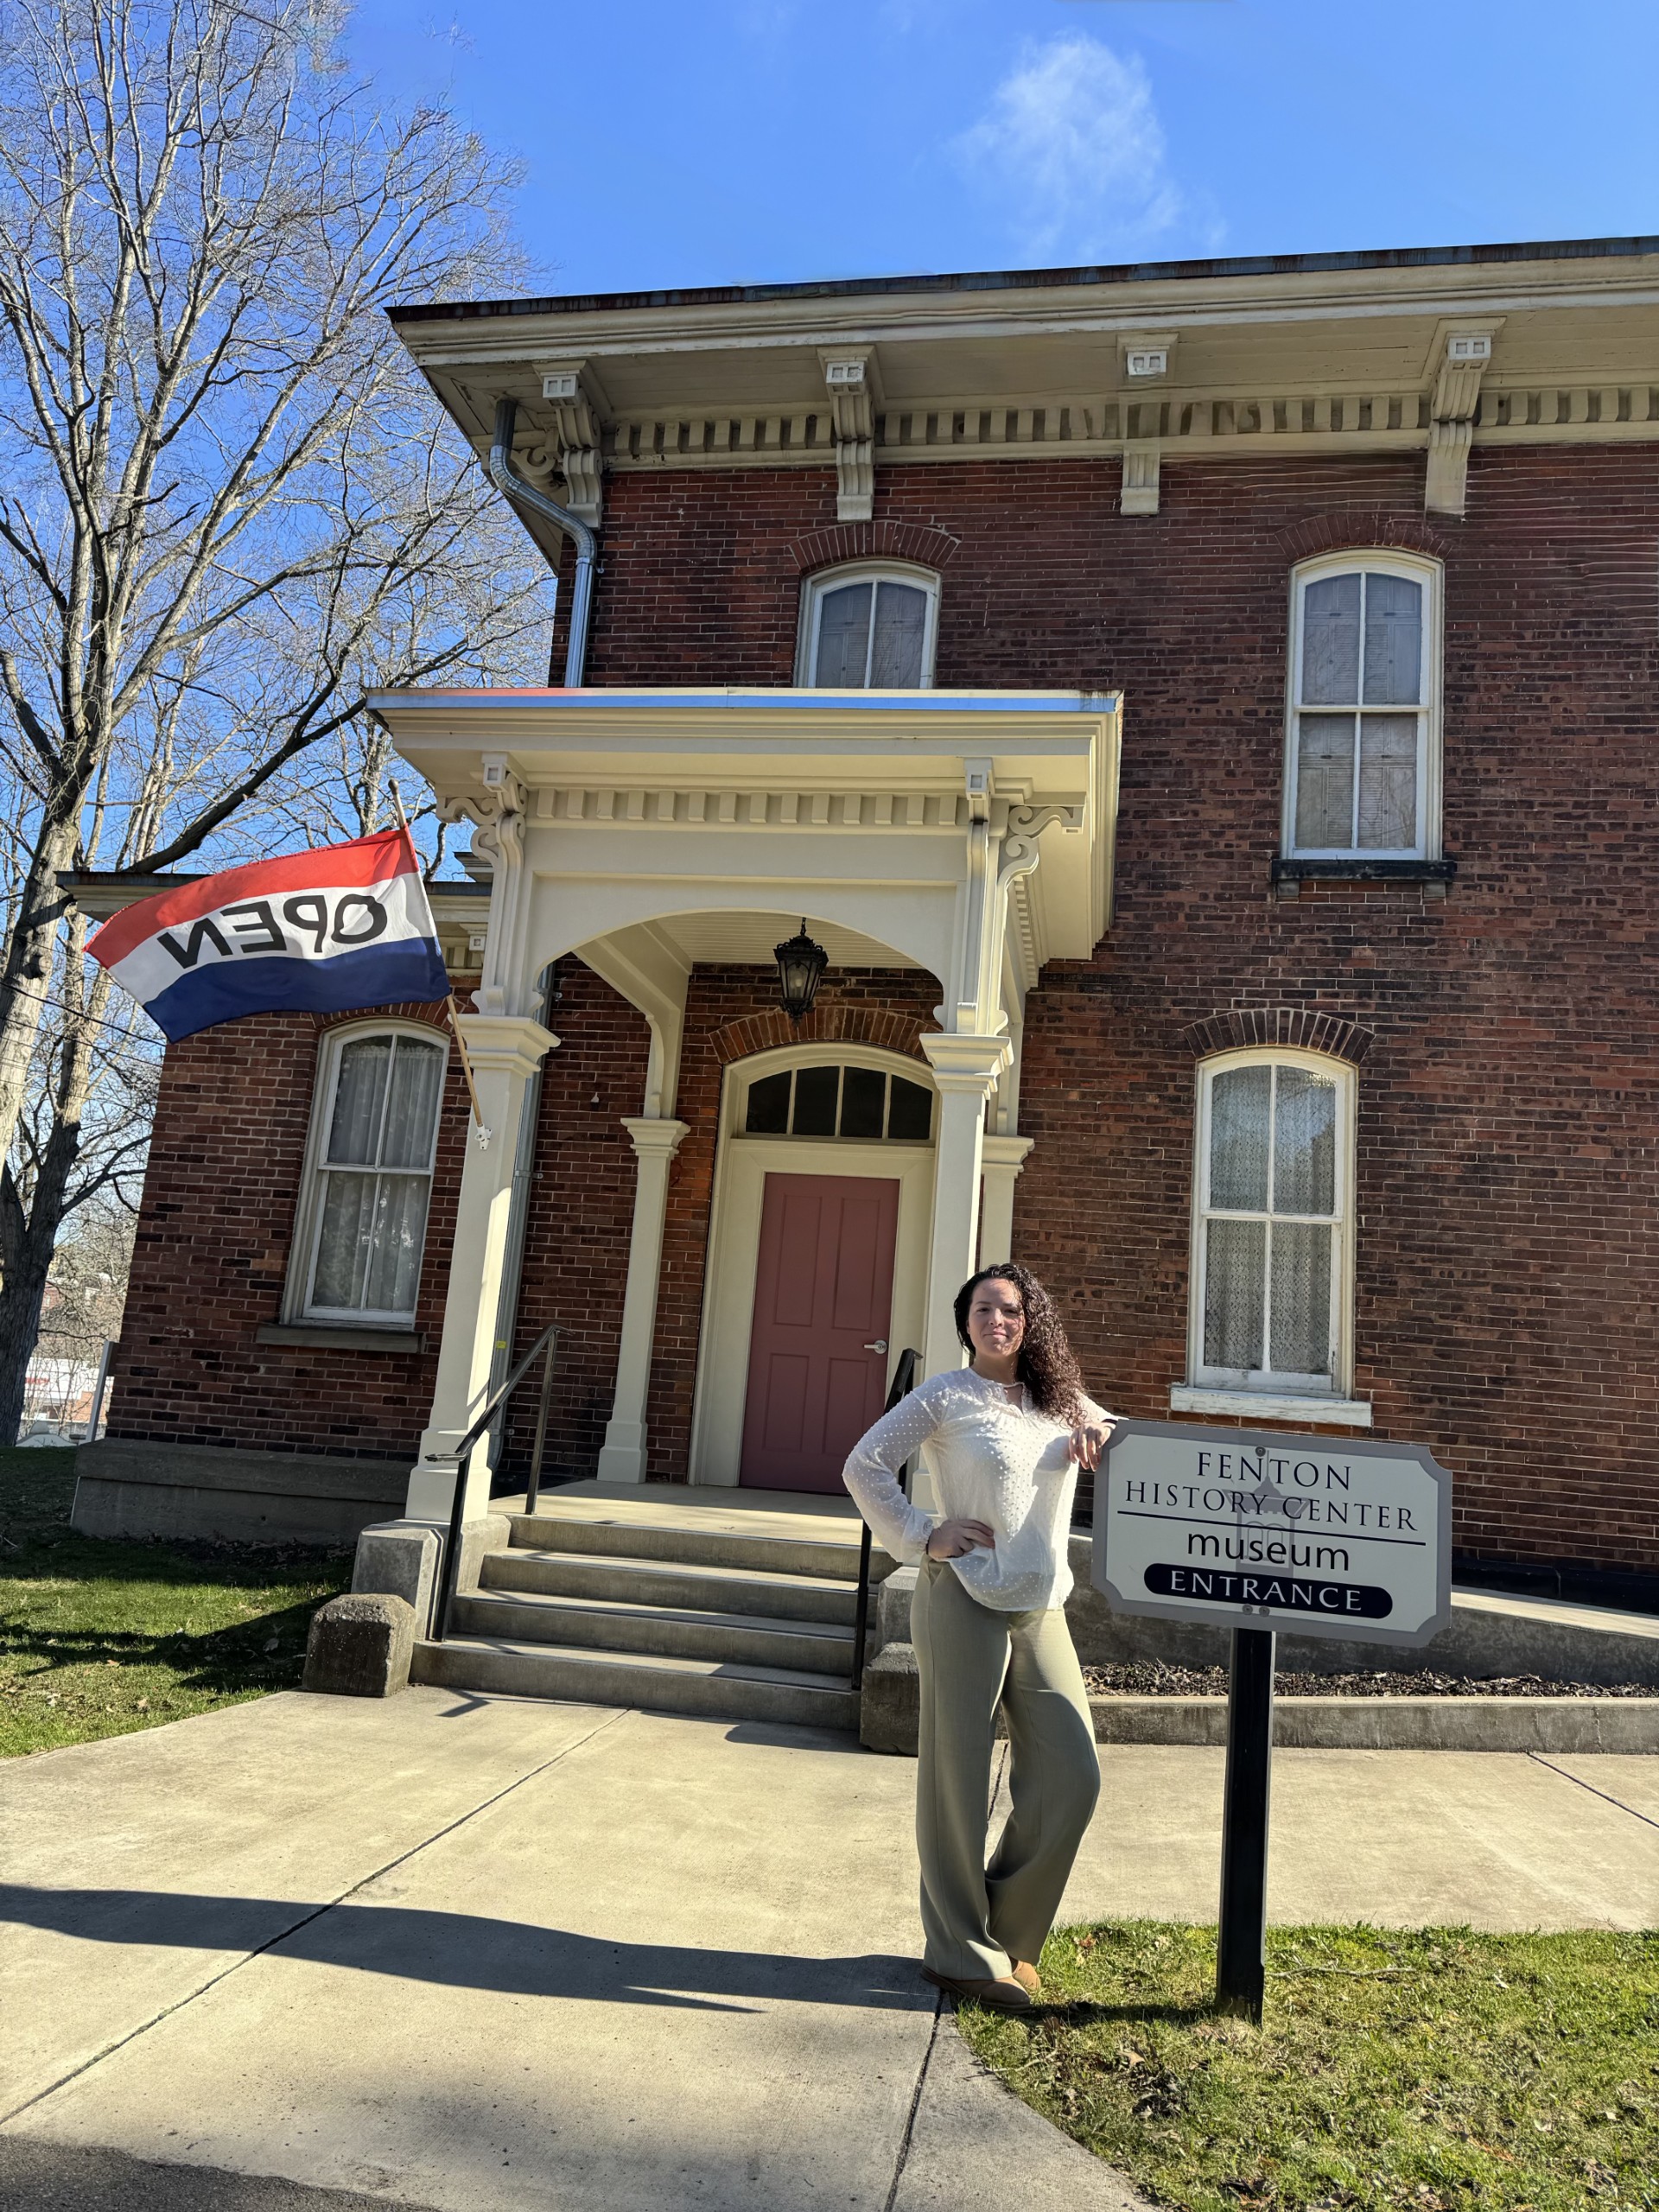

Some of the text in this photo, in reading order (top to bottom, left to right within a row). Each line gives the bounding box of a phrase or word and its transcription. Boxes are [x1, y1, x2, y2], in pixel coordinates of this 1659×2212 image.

[1197, 1451, 1351, 1491] FENTON
[1125, 1479, 1418, 1532] HISTORY CENTER
[1187, 1532, 1350, 1572] museum
[1170, 1569, 1362, 1611] ENTRANCE
